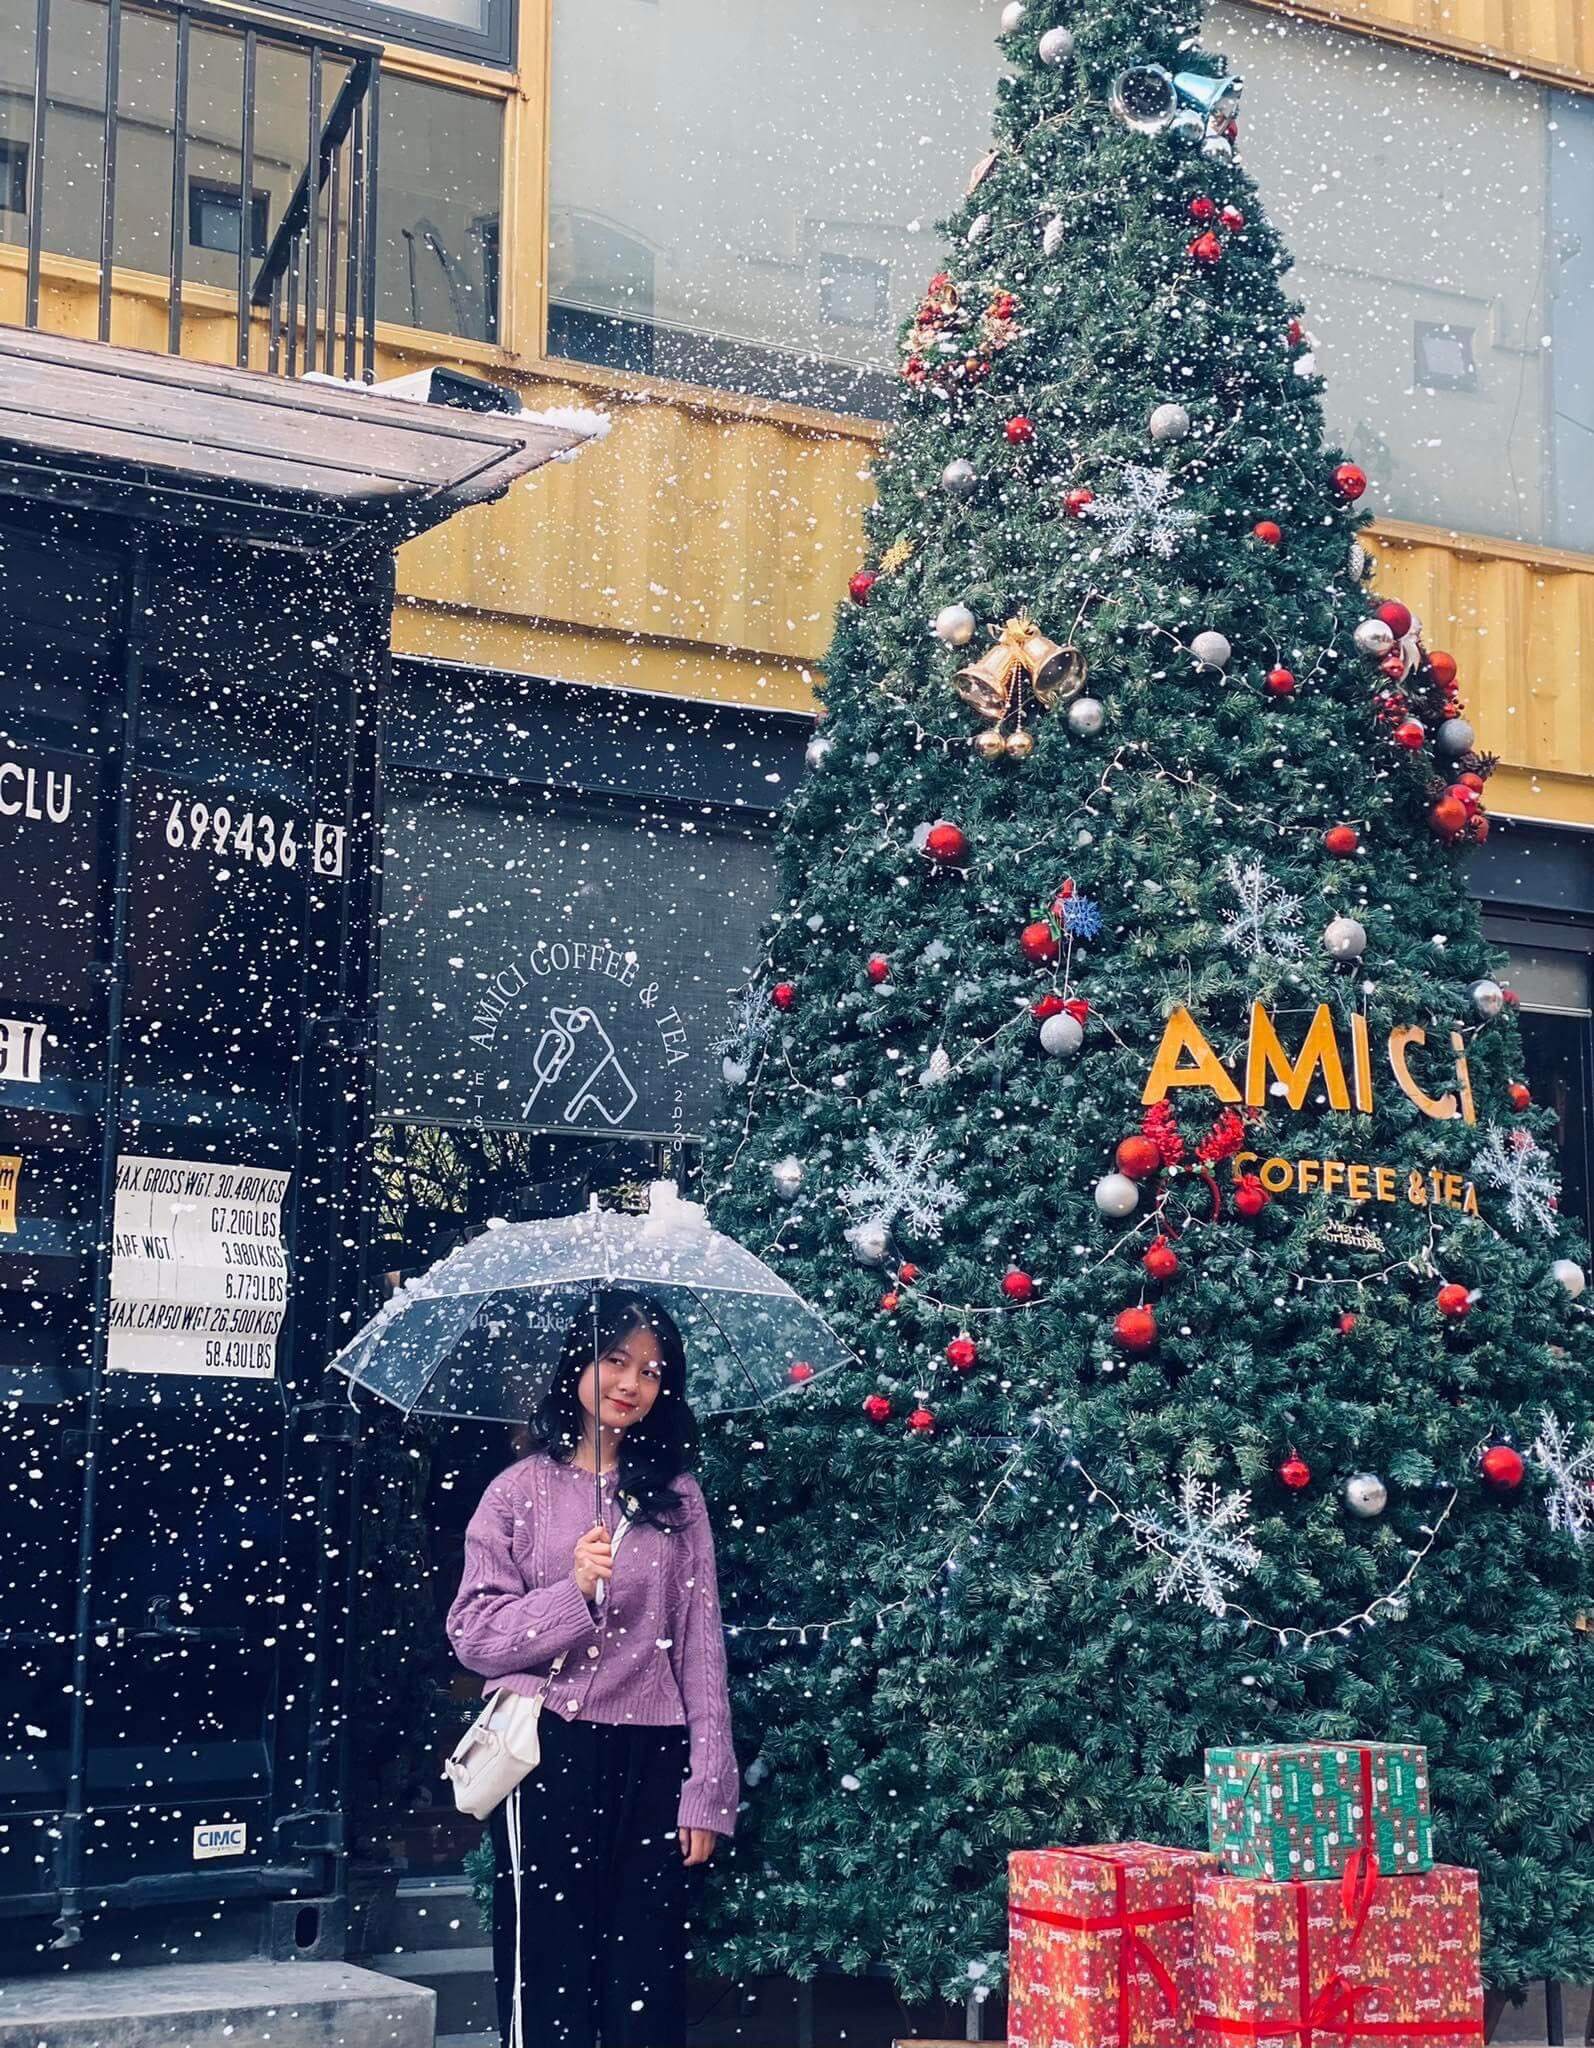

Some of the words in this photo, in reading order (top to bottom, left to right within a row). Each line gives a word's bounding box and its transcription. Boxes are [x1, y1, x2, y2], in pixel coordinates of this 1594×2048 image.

[166, 800, 297, 867] 699436
[468, 961, 529, 1052] AMICI
[529, 941, 640, 988] COFFEE
[639, 982, 660, 1009] &
[655, 1005, 690, 1066] TEA
[1141, 1000, 1476, 1126] AMICI
[143, 1168, 185, 1194] GROSS
[1408, 1168, 1427, 1207] &
[1429, 1167, 1480, 1217] TEA
[197, 1829, 241, 1847] CIMC
